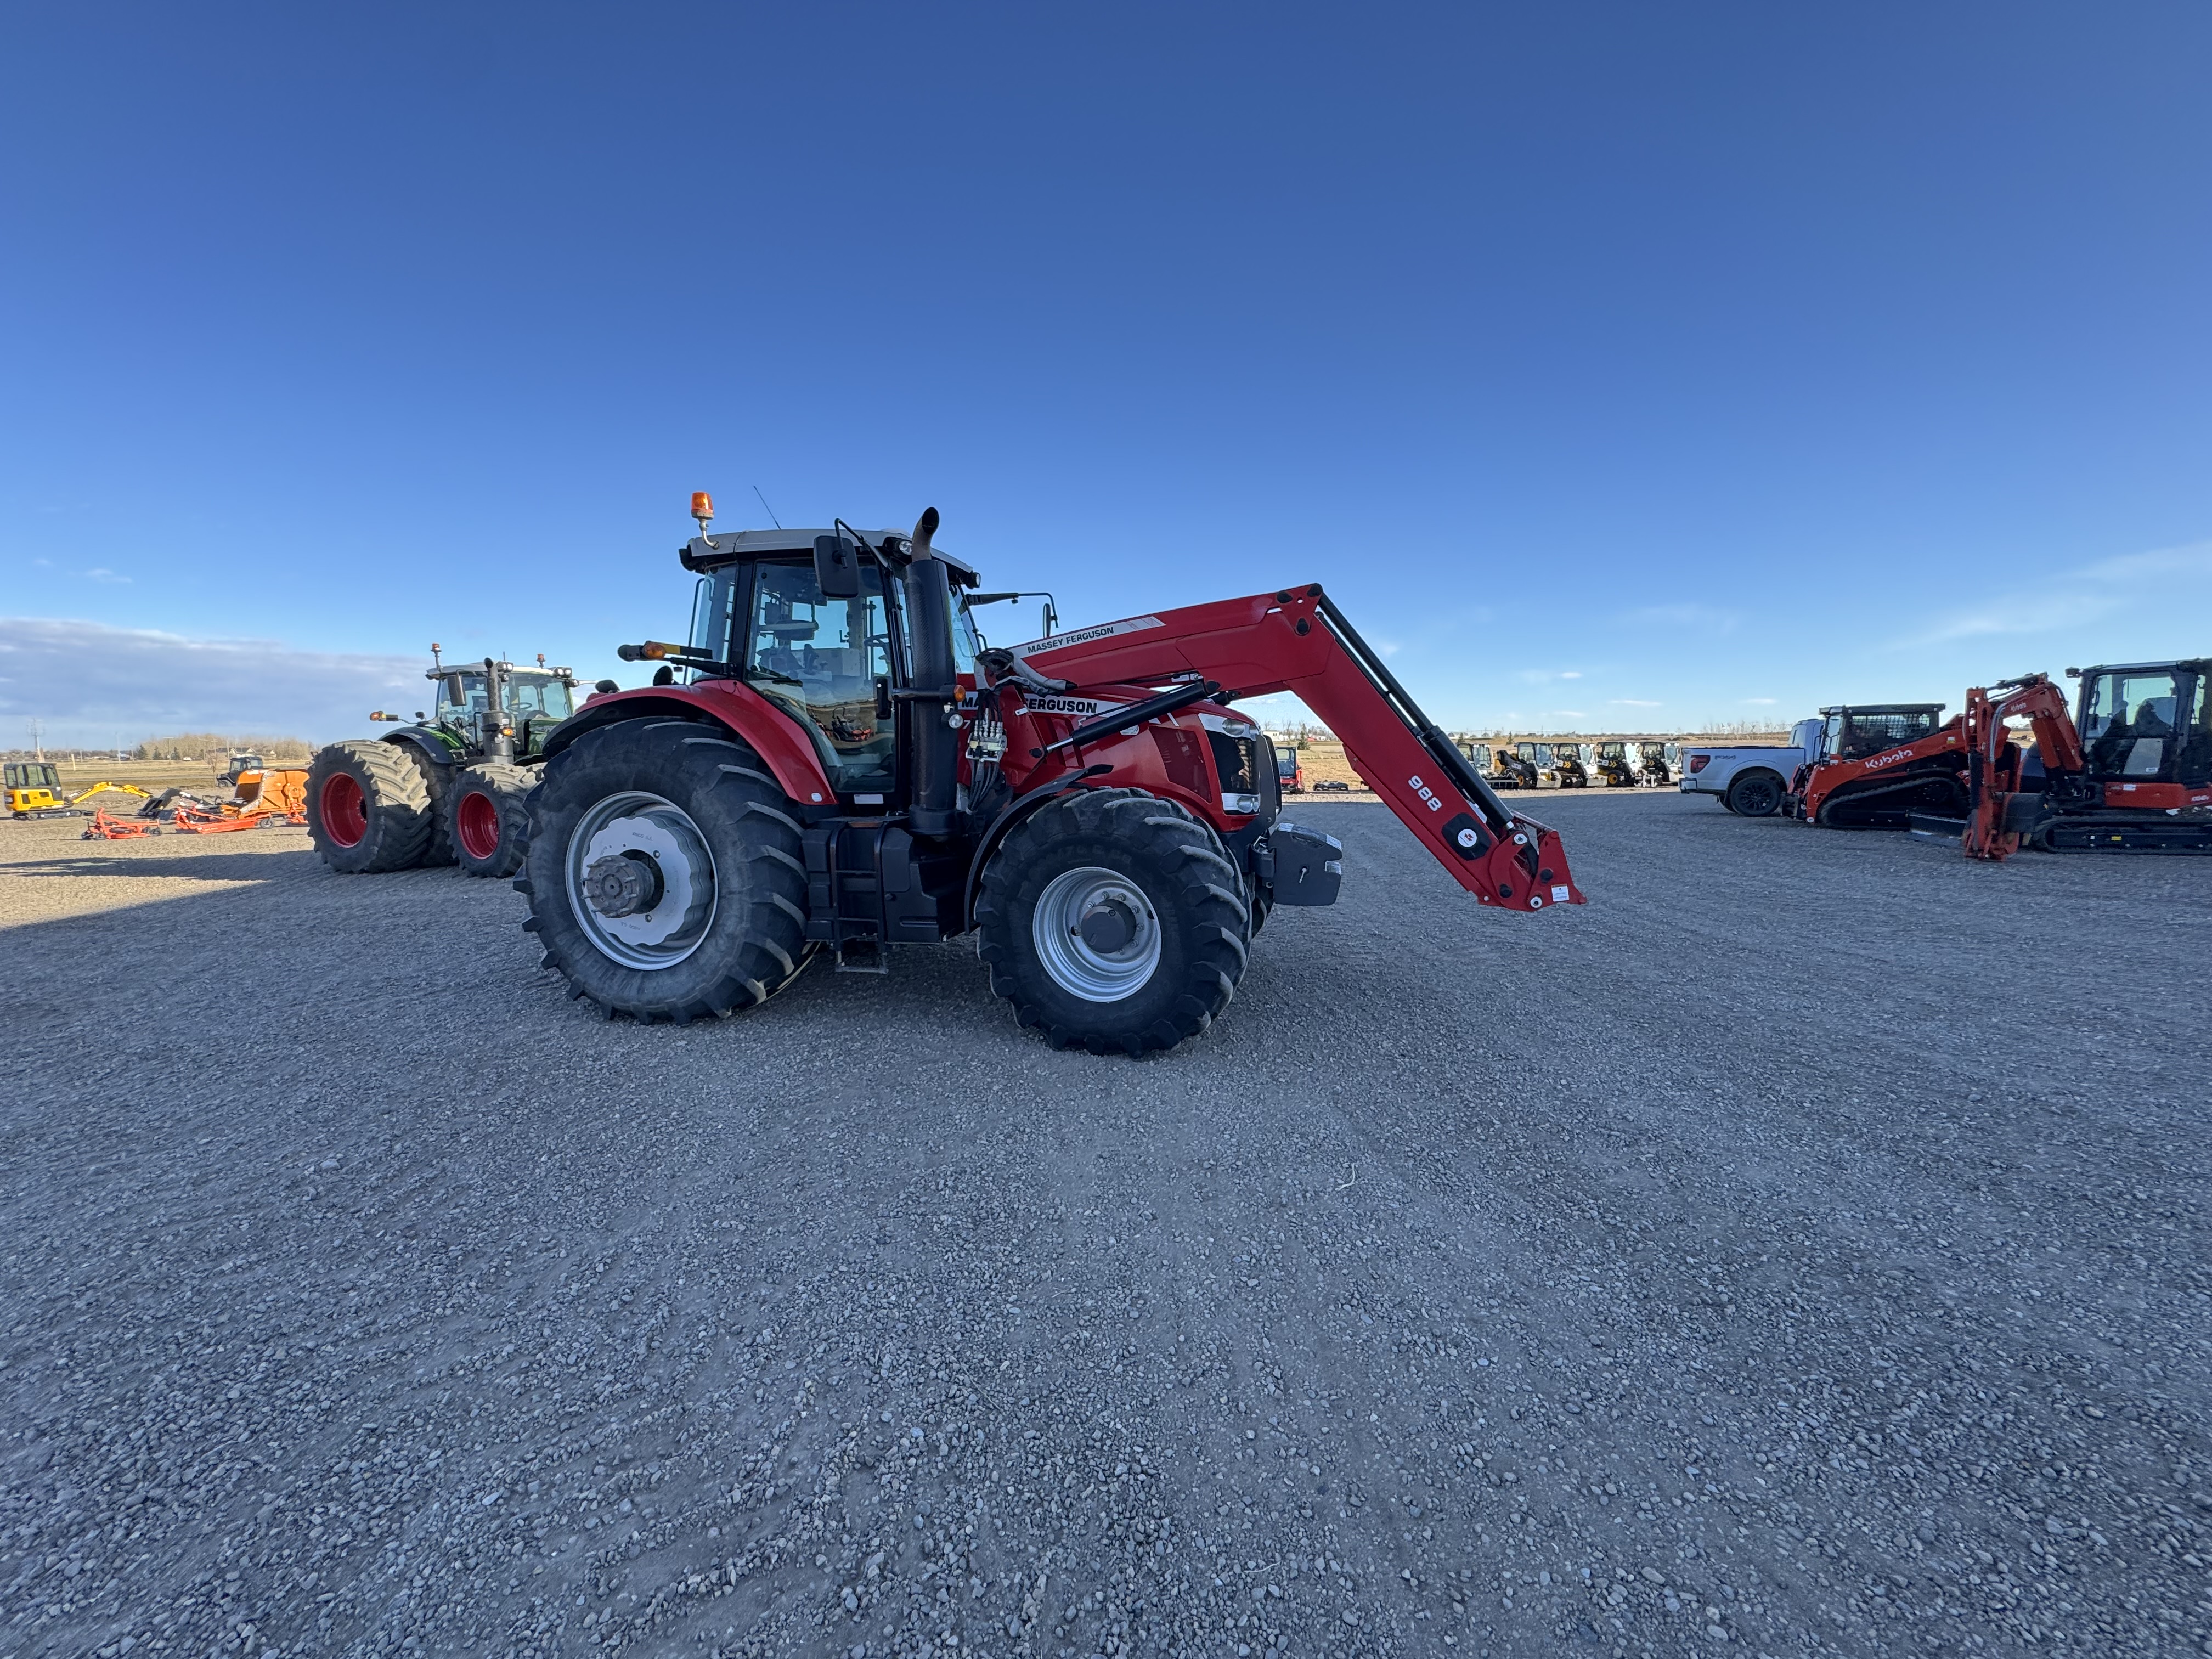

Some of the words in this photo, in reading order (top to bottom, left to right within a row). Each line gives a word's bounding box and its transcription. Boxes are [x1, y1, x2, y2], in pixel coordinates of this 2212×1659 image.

[1028, 638, 1063, 653] MASSEY
[1066, 627, 1114, 644] FERGUSON
[1865, 749, 1914, 768] Kubota
[1408, 775, 1442, 812] 988
